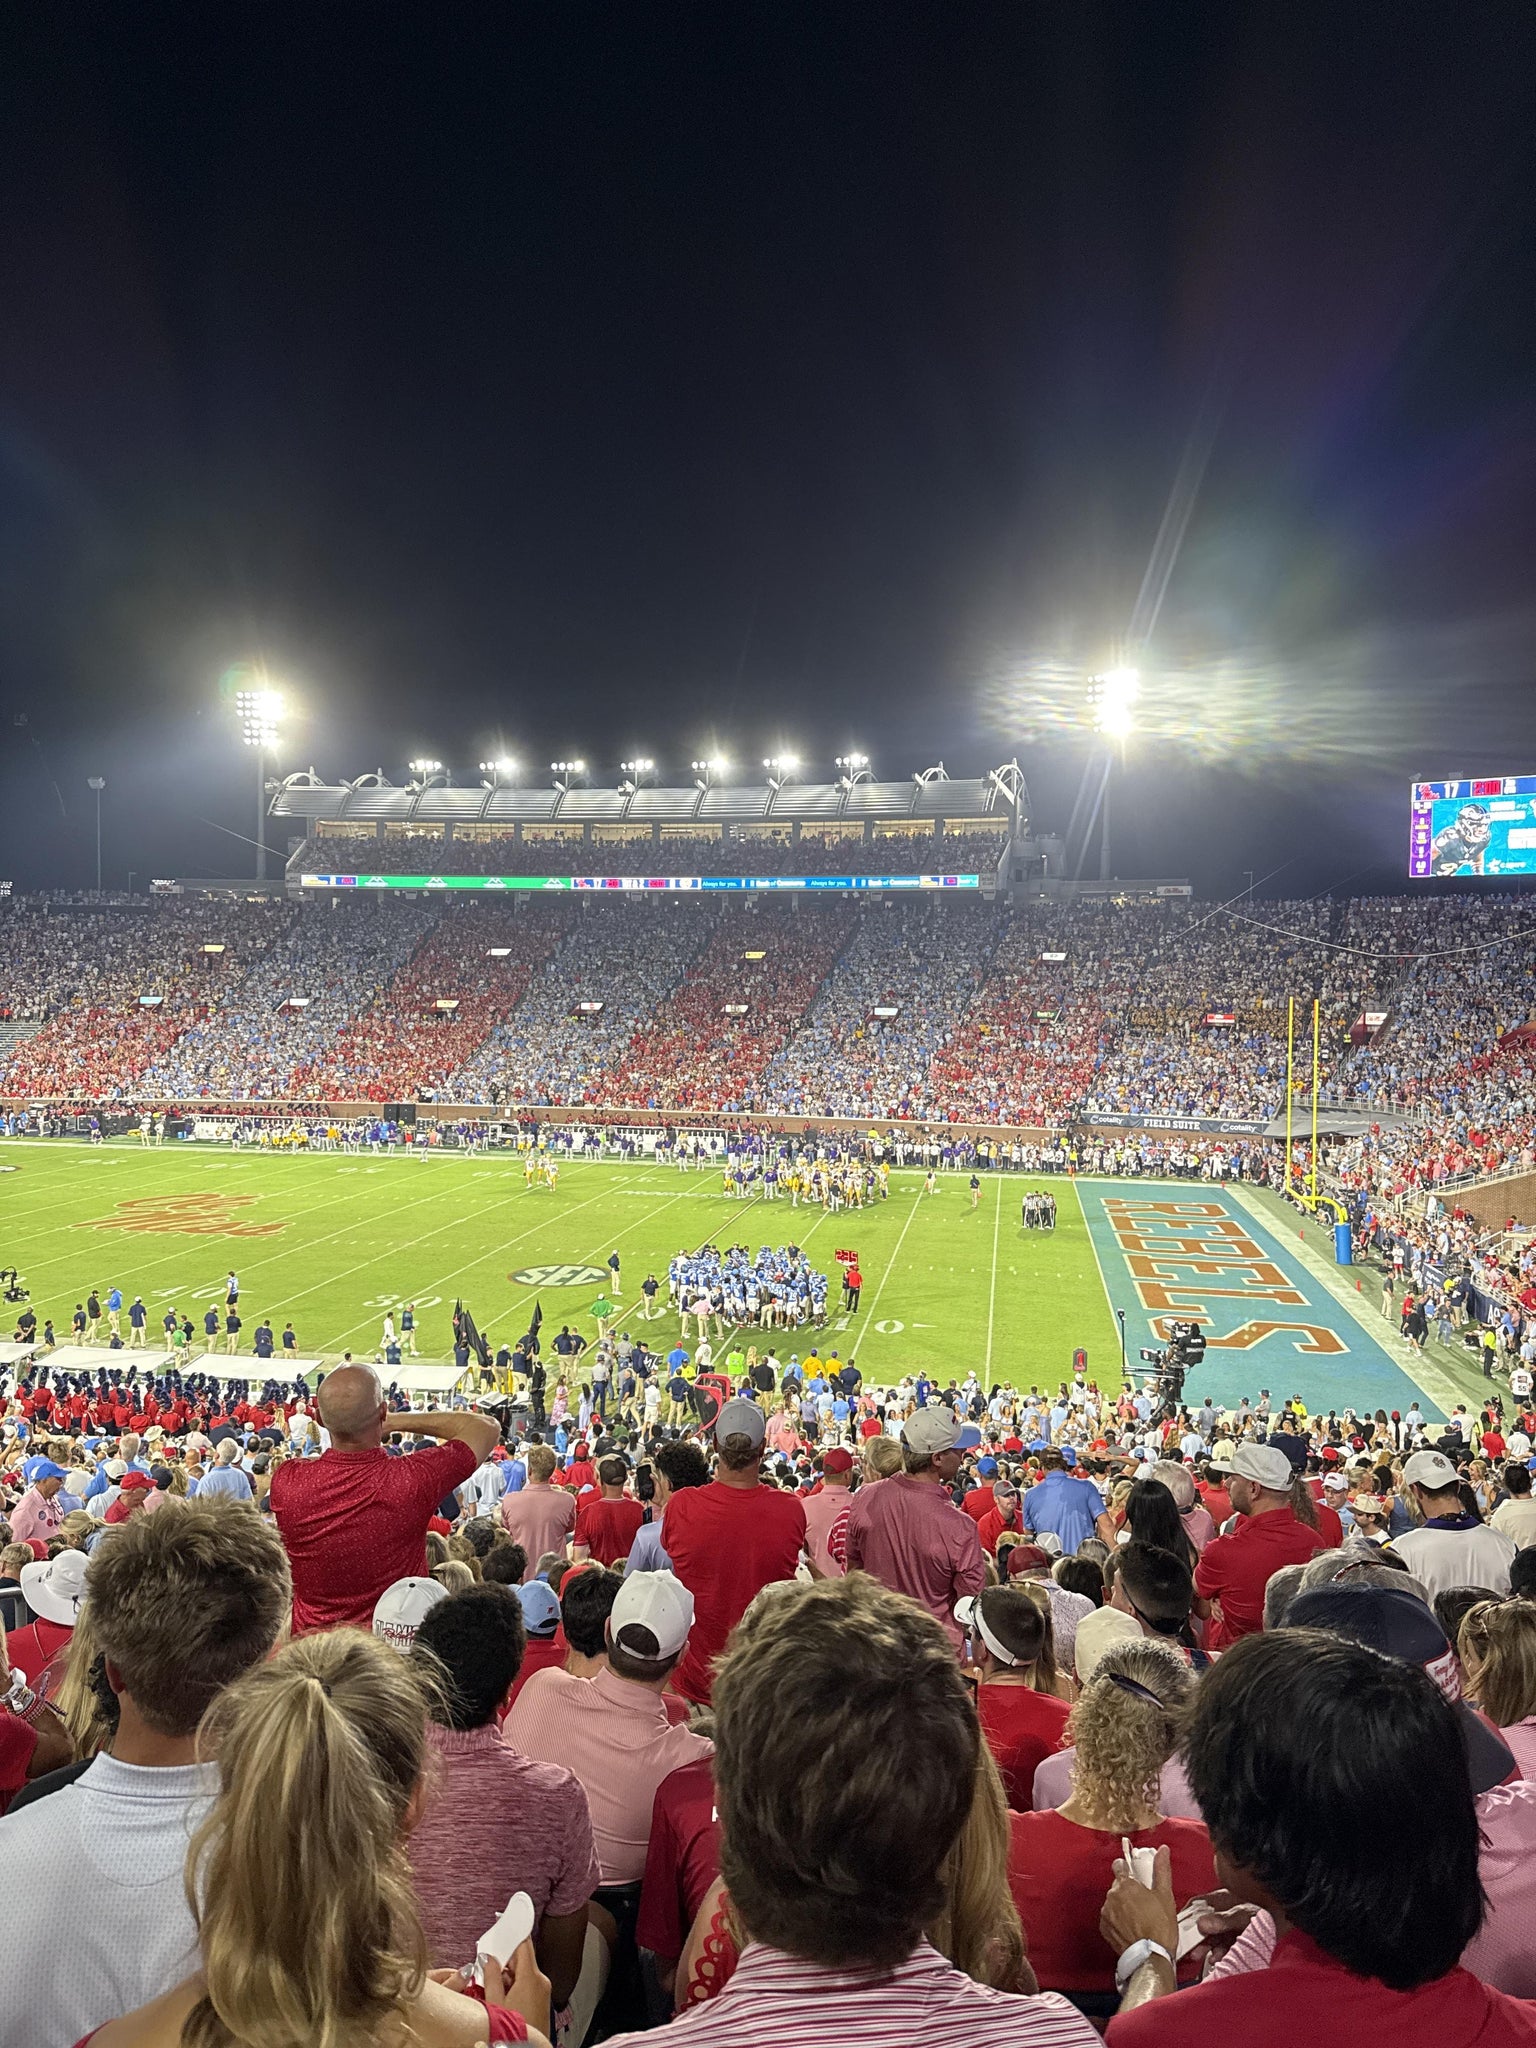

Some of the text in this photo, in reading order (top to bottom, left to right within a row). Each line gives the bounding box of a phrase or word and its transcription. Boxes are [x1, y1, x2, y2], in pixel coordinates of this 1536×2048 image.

[1444, 782, 1459, 798] 17
[1473, 780, 1501, 796] 2:00
[702, 880, 718, 888] Always
[810, 880, 828, 888] Always
[1098, 1116, 1124, 1125] cotality
[1143, 1118, 1201, 1130] FIELD SUITE
[1229, 1122, 1257, 1133] cotality
[113, 1192, 265, 1211] Ole
[66, 1208, 296, 1237] Miss
[515, 1264, 607, 1286] SEC
[1100, 1197, 1352, 1356] REBELS
